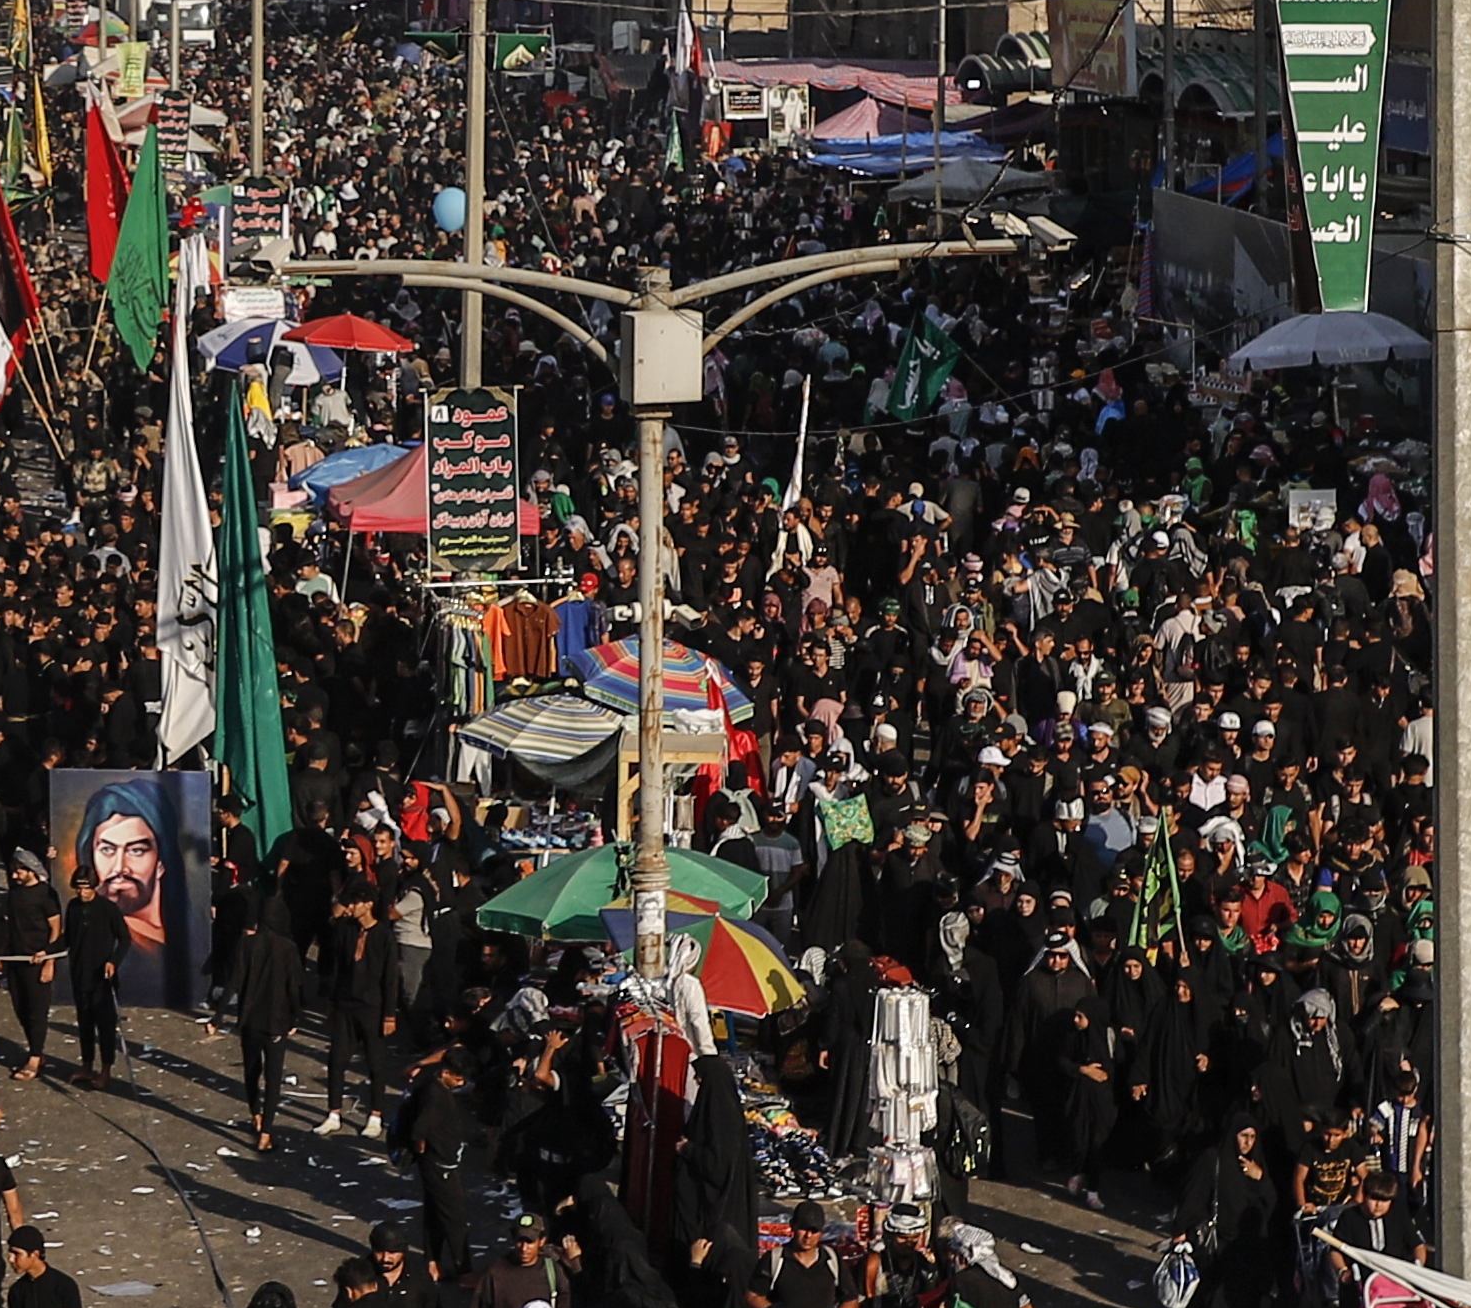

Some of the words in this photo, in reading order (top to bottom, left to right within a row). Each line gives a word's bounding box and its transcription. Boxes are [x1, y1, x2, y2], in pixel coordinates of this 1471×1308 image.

[452, 405, 509, 428] عمود
[432, 430, 511, 454] موكب
[432, 457, 482, 479] المراد
[482, 456, 513, 478] باب
